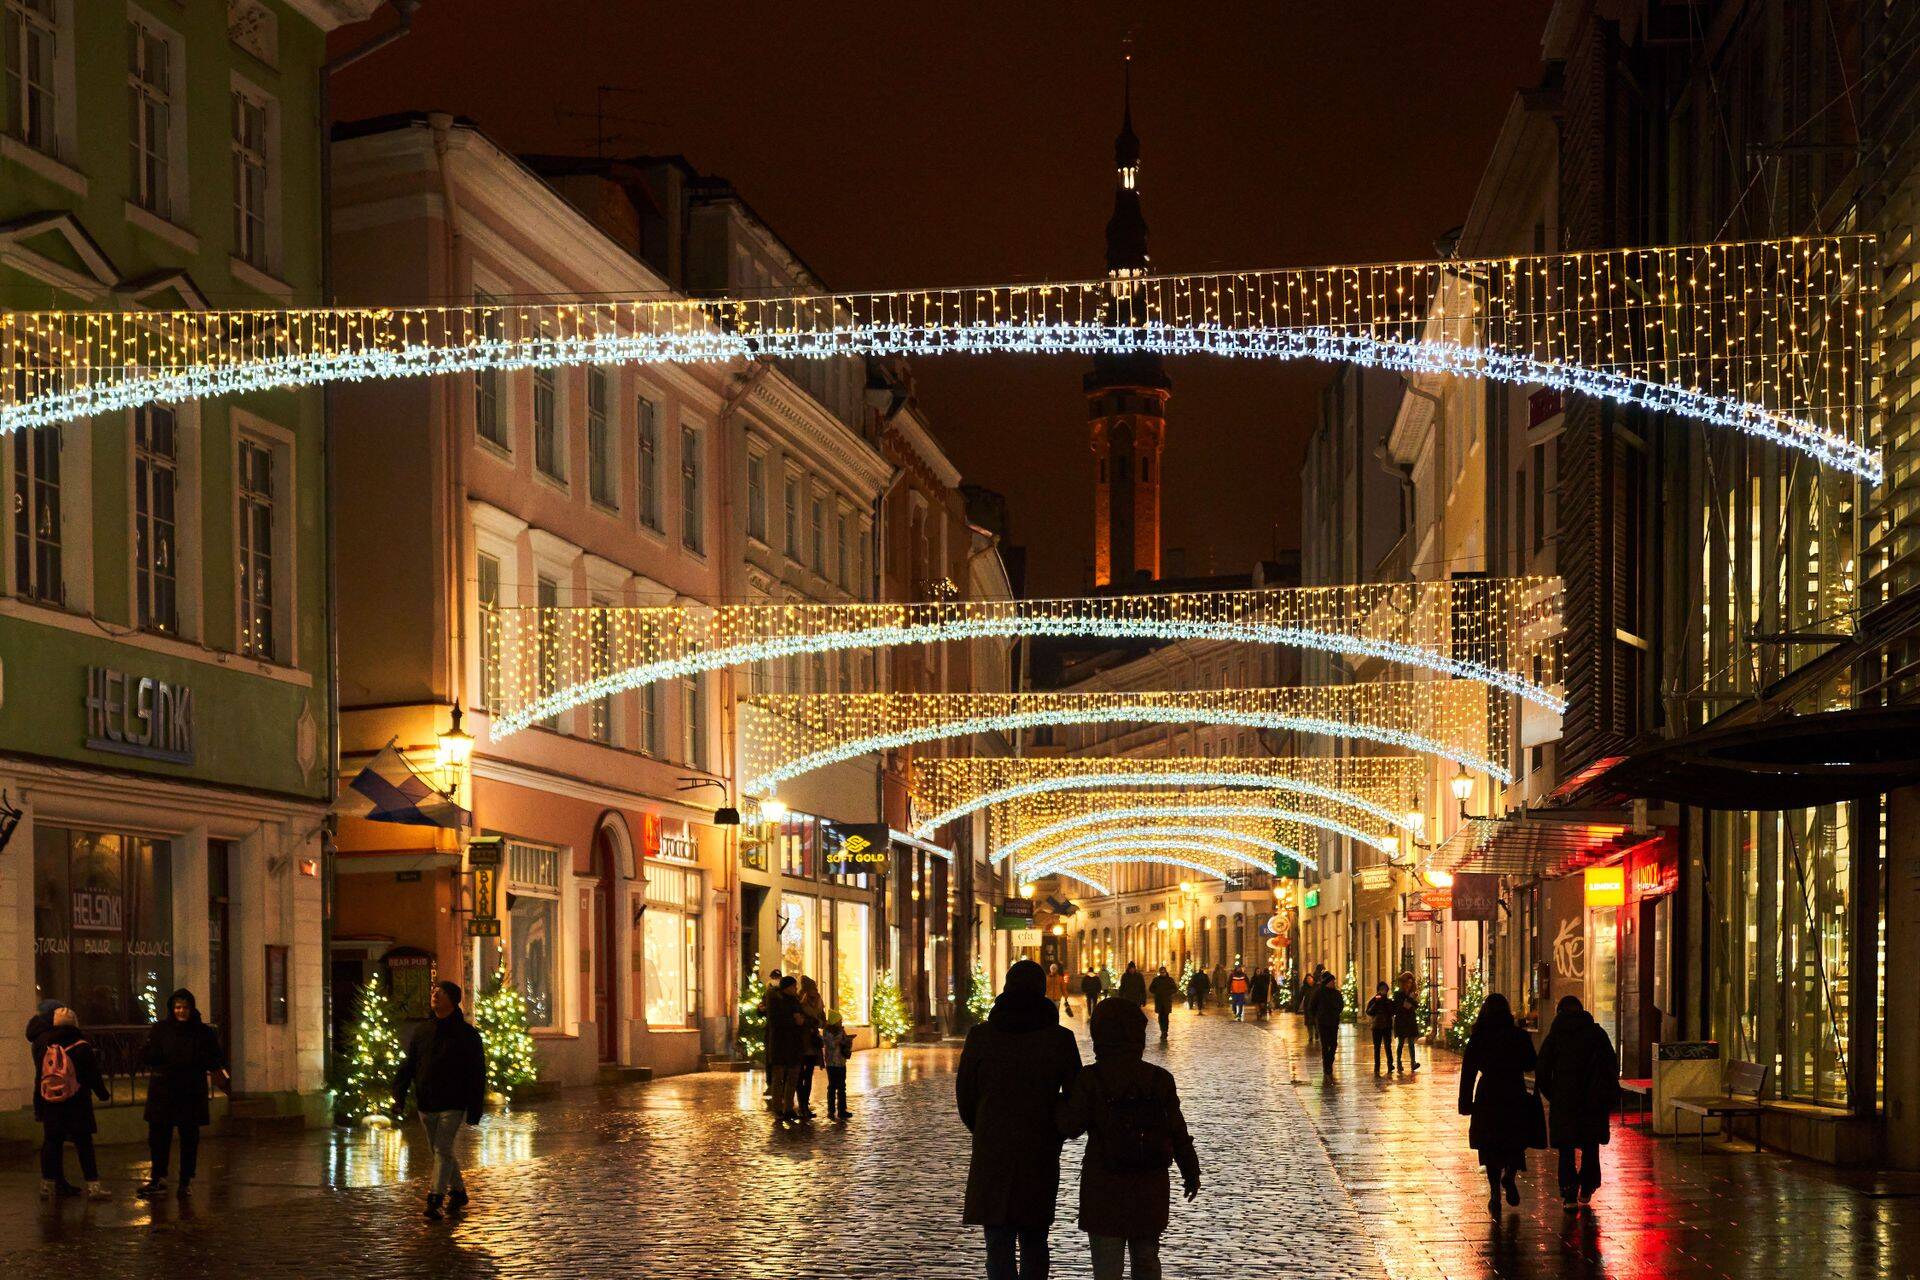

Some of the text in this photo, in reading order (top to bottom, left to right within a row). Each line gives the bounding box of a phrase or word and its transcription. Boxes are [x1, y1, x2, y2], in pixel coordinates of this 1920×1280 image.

[86, 664, 194, 754] HELSINKI
[826, 853, 885, 863] SOFT GOLD
[73, 892, 122, 927] HELSINKI
[84, 939, 112, 955] BAAR
